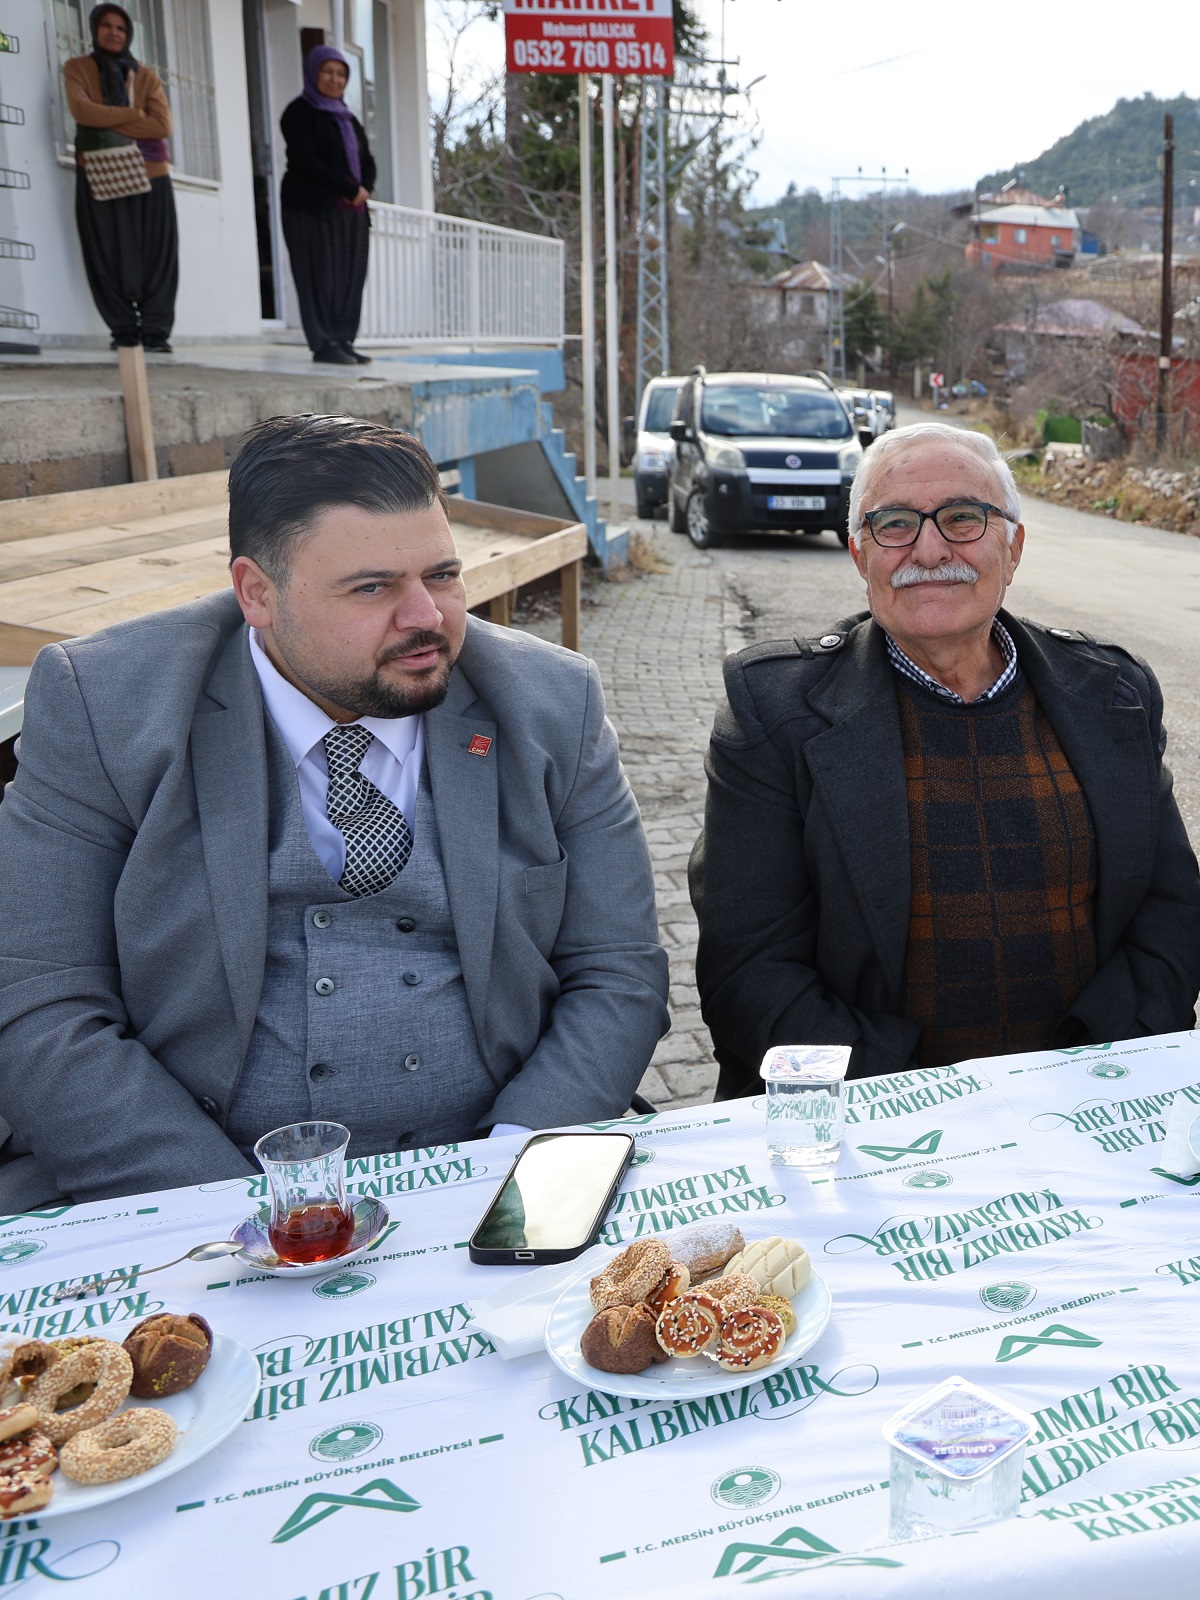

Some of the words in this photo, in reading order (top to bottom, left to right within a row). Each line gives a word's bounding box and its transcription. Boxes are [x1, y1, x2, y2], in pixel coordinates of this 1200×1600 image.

[542, 21, 588, 38] Mehmet
[513, 39, 566, 68] 0532
[570, 40, 610, 69] 760
[614, 41, 667, 69] 9514
[471, 747, 486, 755] CHP
[870, 1074, 992, 1121] KAYBIMIZ
[656, 1122, 693, 1136] MERSİN
[1091, 1126, 1145, 1153] BİR
[945, 1150, 981, 1163] MERSİN
[615, 1164, 753, 1219] KALBİMİZ
[628, 1185, 784, 1239] KAYBIMIZ
[61, 1214, 106, 1228] MERSİN
[867, 1216, 926, 1257] BİR
[926, 1188, 1064, 1245] KALBİMİZ
[952, 1209, 1103, 1270] KAYBIMIZ
[382, 1247, 428, 1262] MERSİN
[891, 1249, 957, 1282] BİR
[303, 1302, 476, 1369] KALBİMİZ
[926, 1334, 949, 1345] T.C.
[949, 1324, 991, 1341] MERSİN
[992, 1306, 1061, 1331] BÜYÜKŞEHİR
[1060, 1288, 1117, 1312] BELEDİYESİ
[318, 1331, 498, 1403] KAYBIMIZ
[1108, 1363, 1182, 1411] BİR
[577, 1386, 760, 1468] KALBİMİZ
[762, 1358, 832, 1410] BİR
[213, 1493, 239, 1505] T.C.
[242, 1480, 300, 1498] MERSİN
[304, 1457, 396, 1485] BÜYÜKŞEHİR
[399, 1439, 473, 1463] BELEDİYESİ
[931, 1442, 997, 1456] ÇAMLIBEL
[1020, 1418, 1156, 1503] ALBİMİZ
[633, 1542, 659, 1555] T.C.
[661, 1527, 714, 1548] MERSİN
[717, 1504, 803, 1533] BÜYÜKŞEHİR
[806, 1484, 875, 1511] BELEDİYESİ
[393, 1546, 478, 1600] BİR
